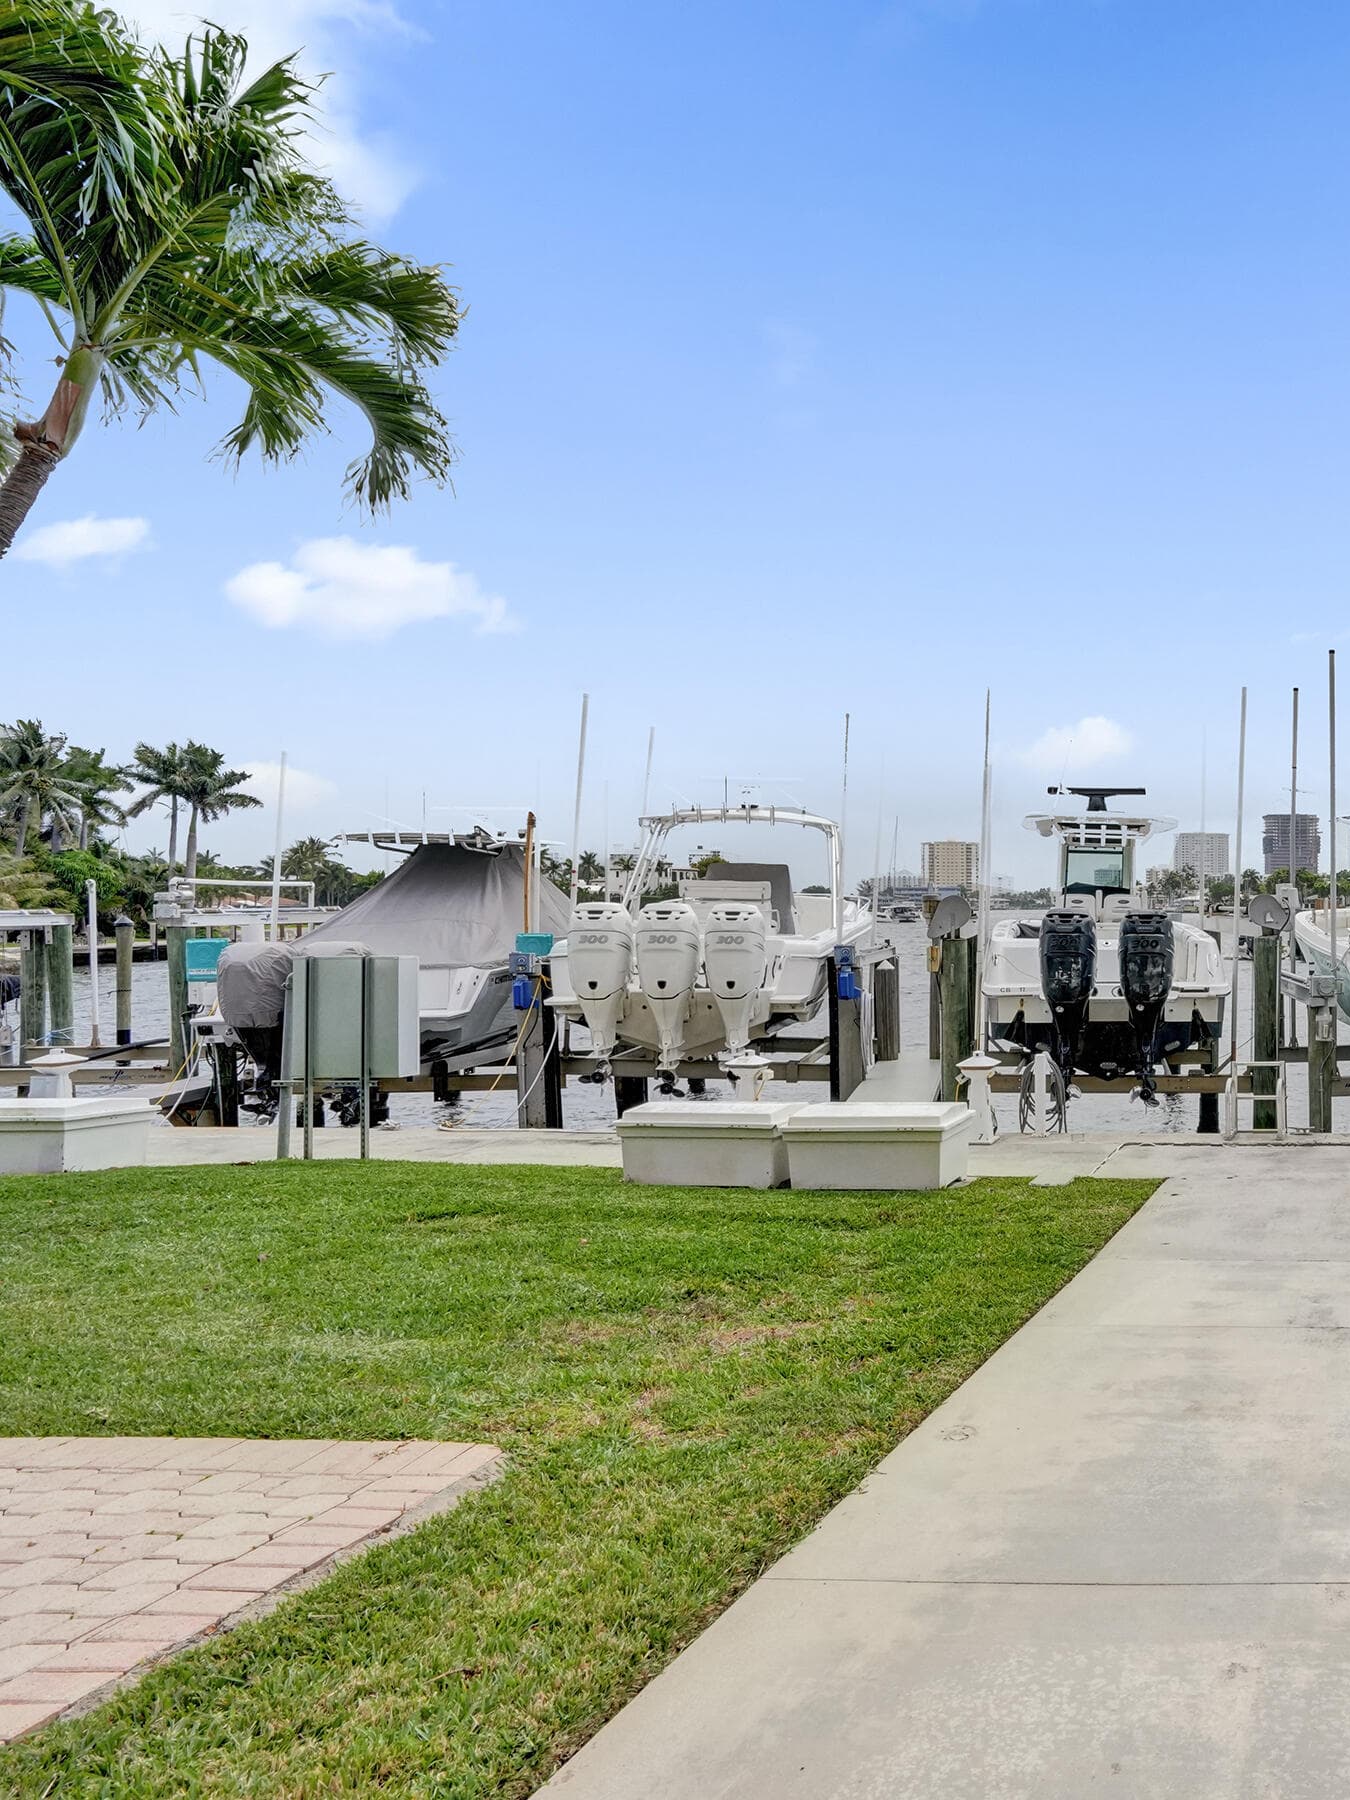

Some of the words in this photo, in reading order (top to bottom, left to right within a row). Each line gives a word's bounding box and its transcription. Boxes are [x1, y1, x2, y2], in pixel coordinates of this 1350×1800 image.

[578, 935, 608, 945] 300
[648, 935, 677, 945] 300
[716, 935, 745, 945] 300
[1132, 939, 1159, 949] 300
